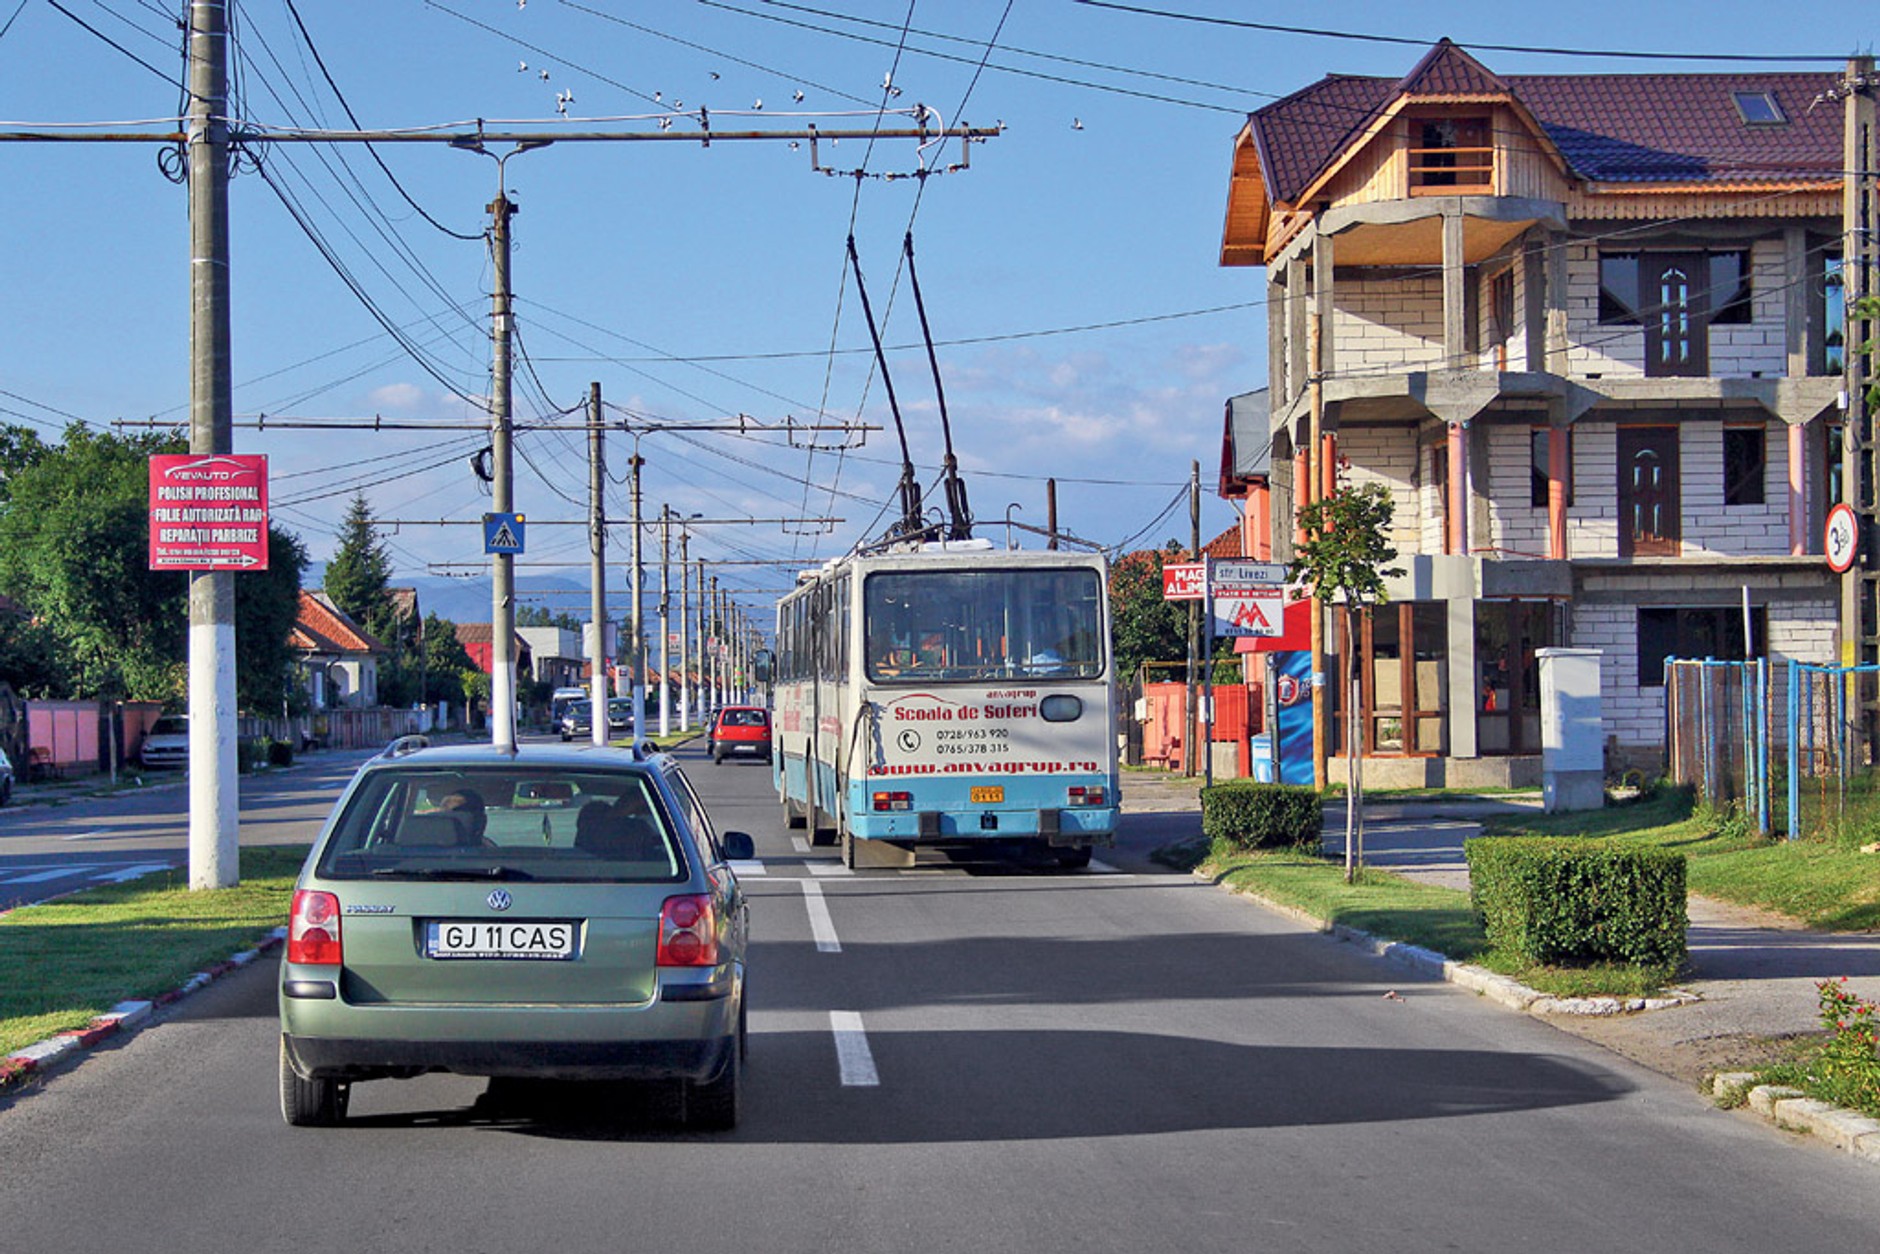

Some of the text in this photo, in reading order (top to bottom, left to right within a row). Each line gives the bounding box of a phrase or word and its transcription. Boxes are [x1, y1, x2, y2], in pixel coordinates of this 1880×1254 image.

[158, 486, 259, 500] POLISH PROFESIONAL
[155, 508, 181, 523] FOLIE
[1175, 569, 1205, 582] MAG
[894, 704, 1037, 721] Scoala de Soferi
[936, 728, 1009, 740] 0728/963 920
[936, 743, 1009, 754] 0765/378 315
[867, 760, 1098, 776] www.anvagrup.ro
[446, 926, 477, 949] GJ
[486, 925, 502, 949] 11
[510, 926, 566, 950] CAS
